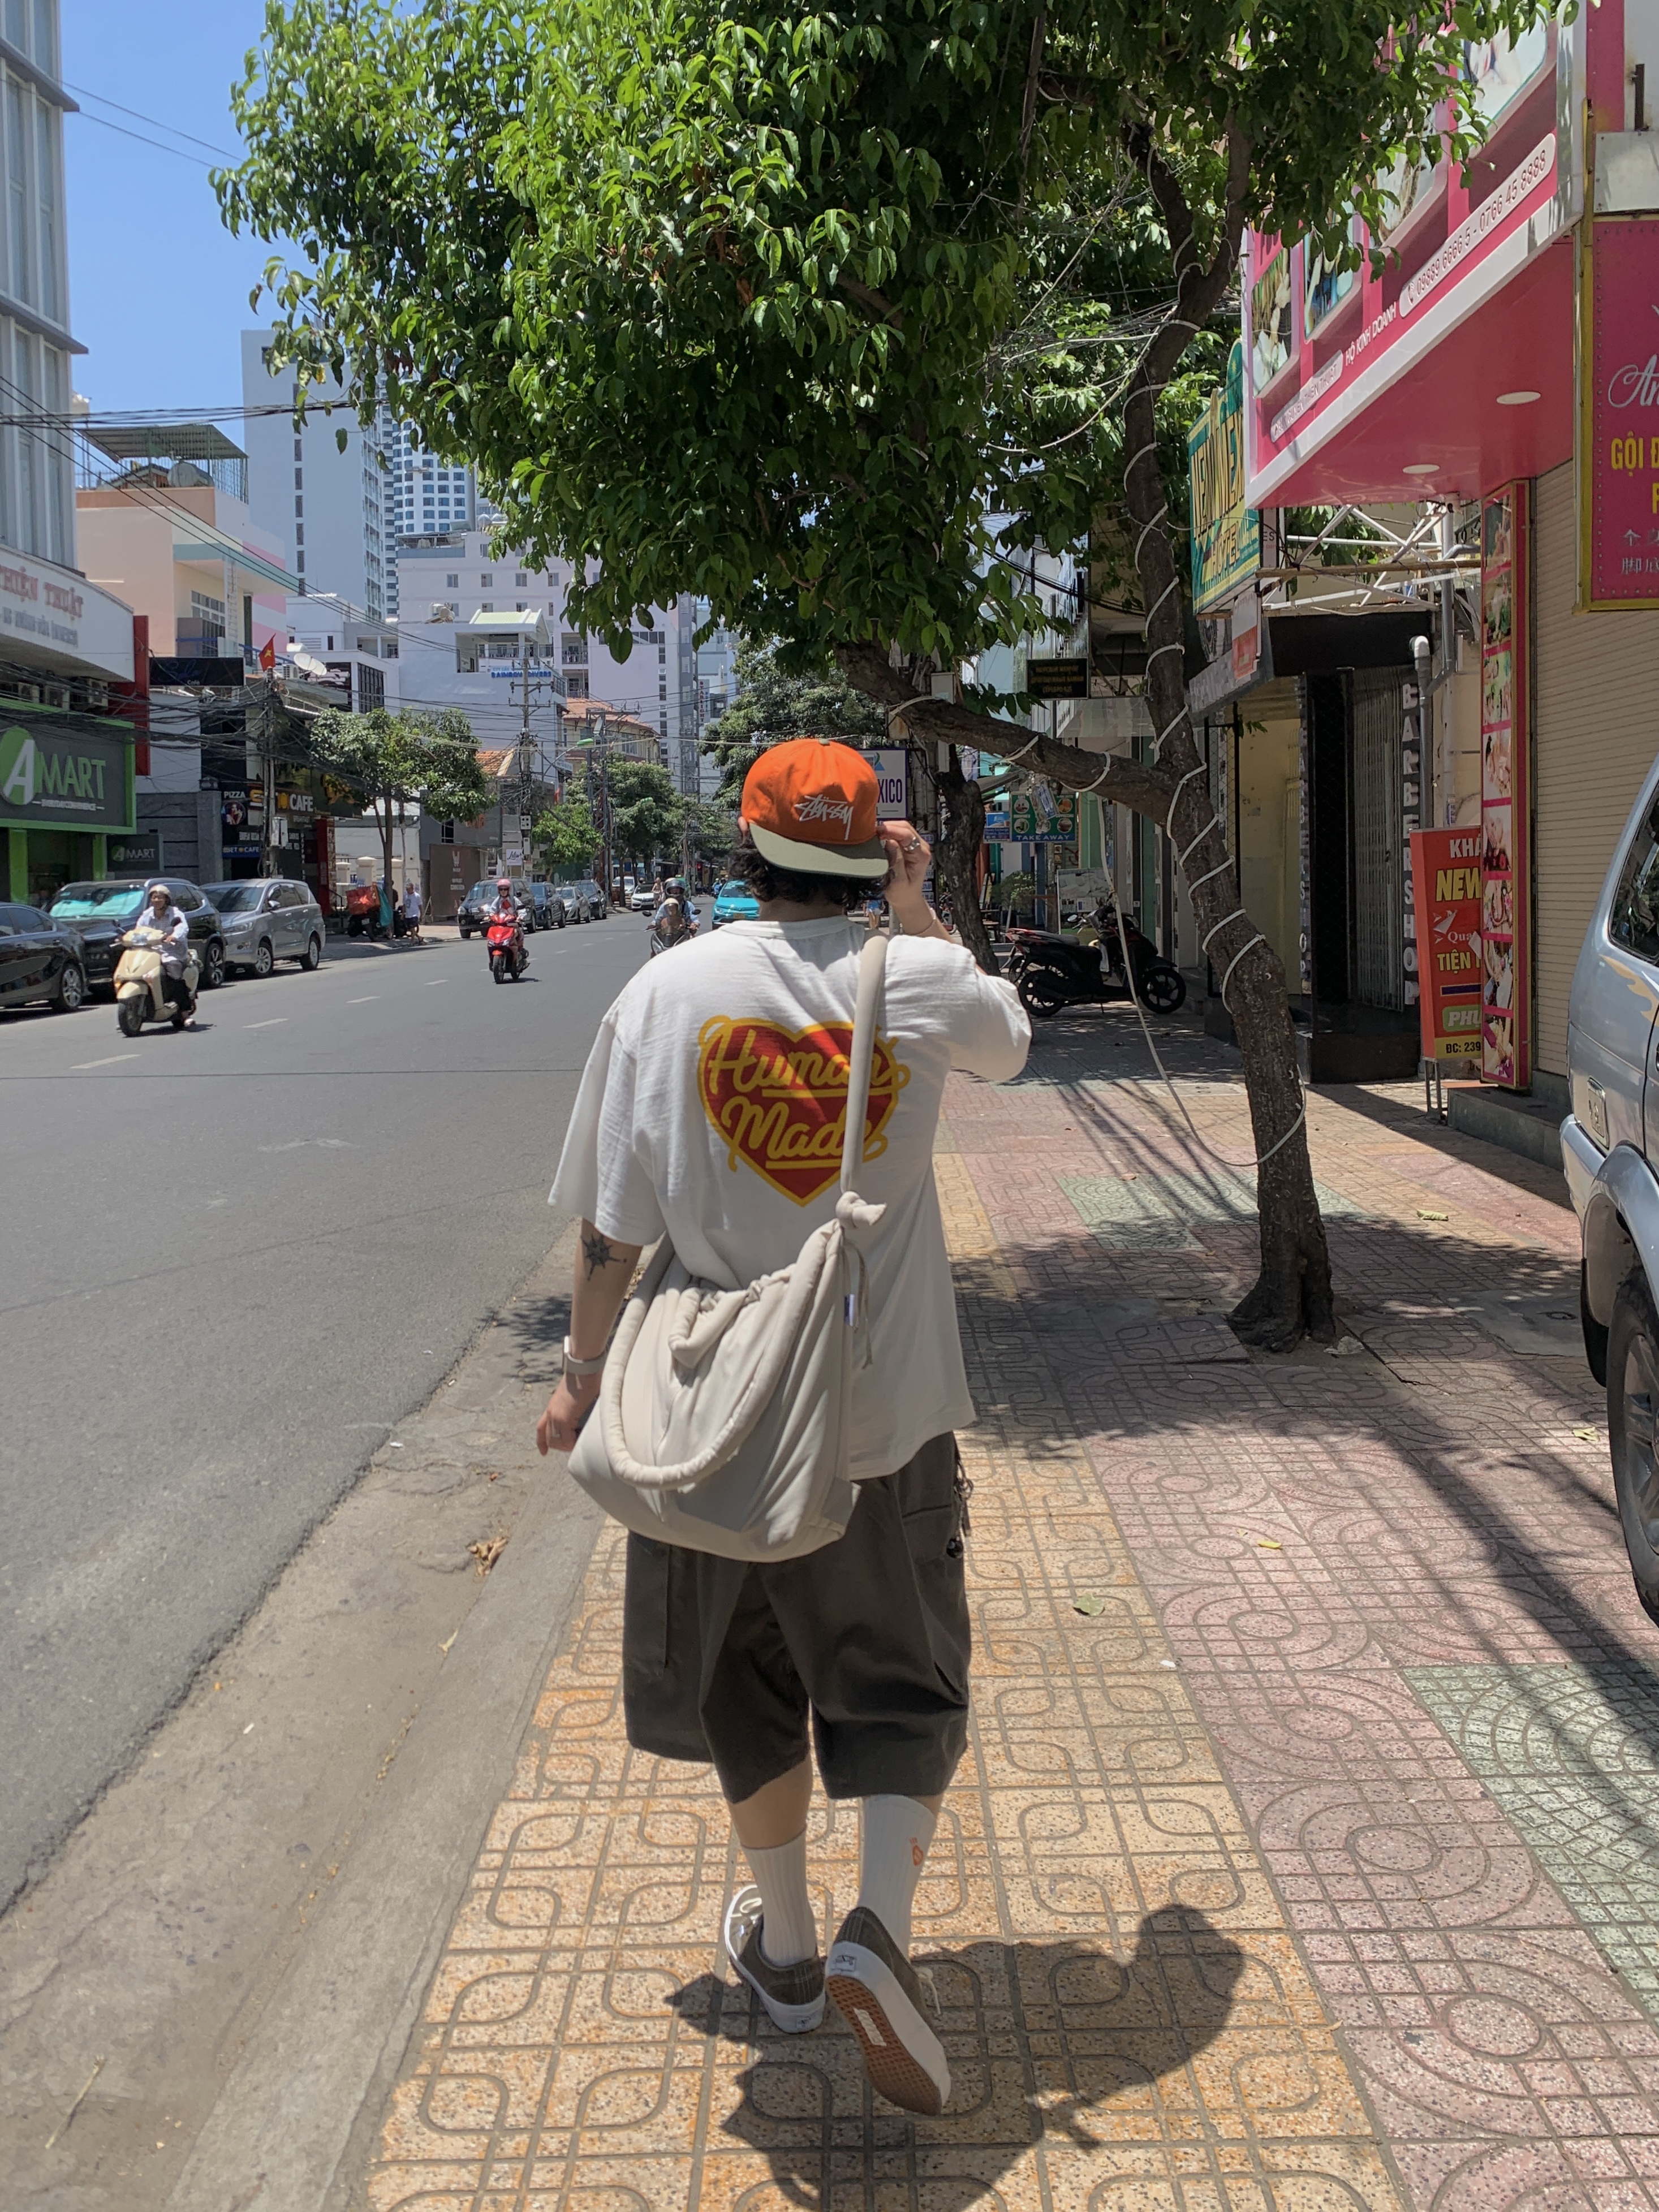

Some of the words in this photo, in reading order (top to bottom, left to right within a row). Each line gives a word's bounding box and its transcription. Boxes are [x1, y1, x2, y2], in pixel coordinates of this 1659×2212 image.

[1442, 235, 1463, 271] 6666
[1464, 226, 1471, 247] 5
[1480, 193, 1502, 232] 0766
[1505, 179, 1518, 205] 45
[1520, 149, 1546, 193] 8888
[1356, 326, 1371, 355] KINH
[1372, 301, 1397, 339] DOANH
[1611, 430, 1644, 476] GỘI
[1210, 520, 1241, 579] HOTEL
[290, 794, 314, 812] CAFE
[877, 778, 903, 804] XICO
[1436, 948, 1471, 975] TIỆN
[1464, 1041, 1481, 1052] 239
